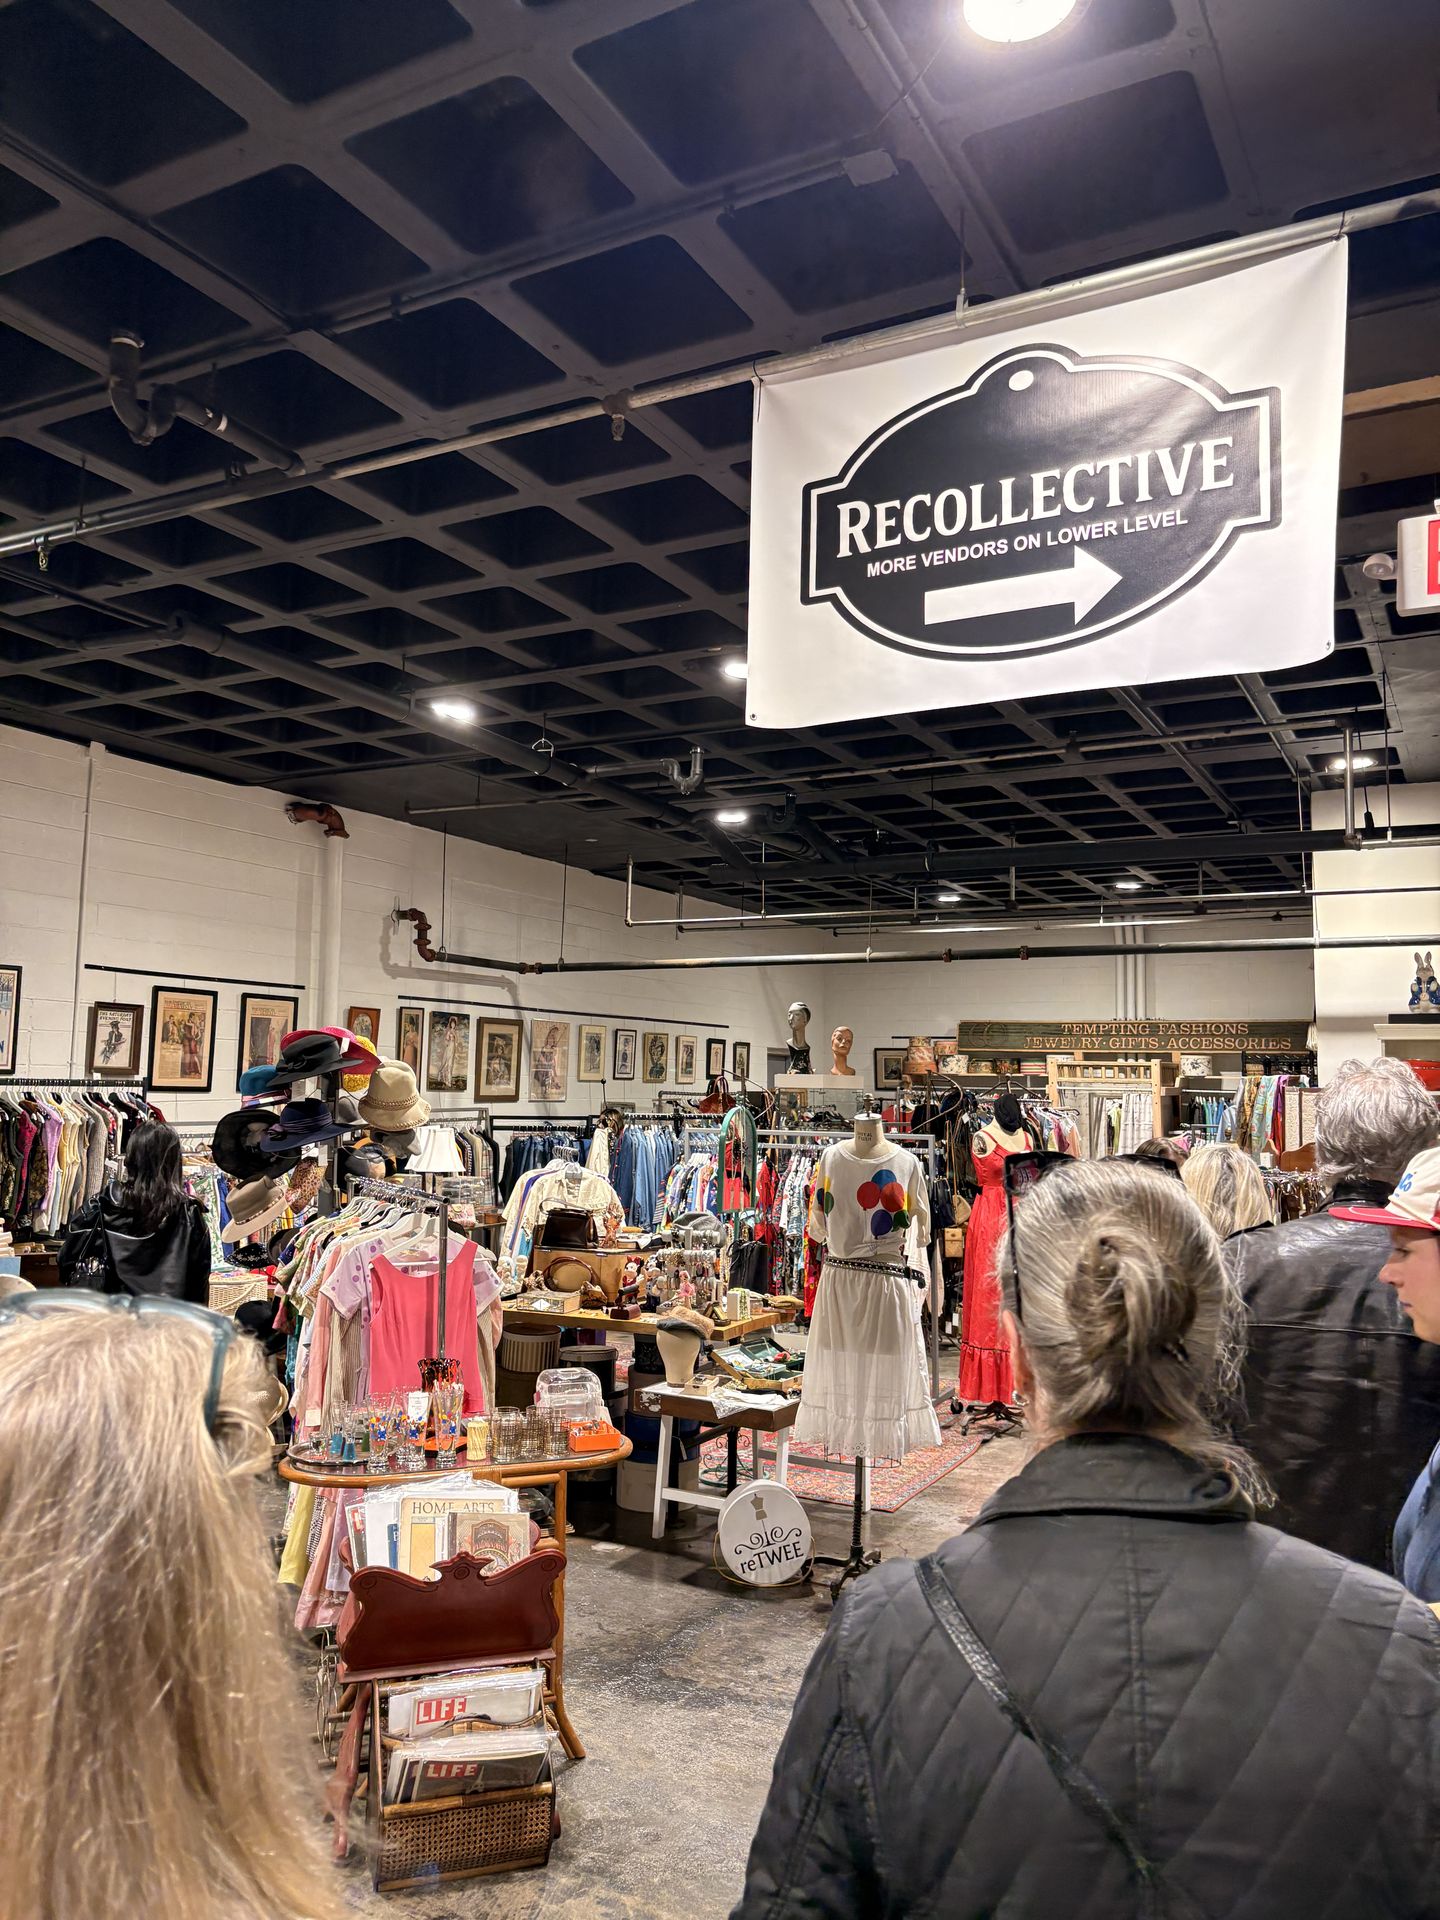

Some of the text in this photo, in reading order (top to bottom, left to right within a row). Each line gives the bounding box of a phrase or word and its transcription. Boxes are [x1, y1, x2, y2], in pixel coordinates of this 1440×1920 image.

[836, 436, 1234, 558] RECOLLECTIVE
[866, 510, 1188, 578] MORE VENDORS ON LOWER LEVEL
[1061, 1024, 1249, 1035] TEMPTING FASHIONS
[412, 1502, 495, 1514] HOME ARTS
[740, 1541, 804, 1574] reTWEE
[418, 1697, 466, 1722] LIFE
[426, 1764, 478, 1777] LIFE
